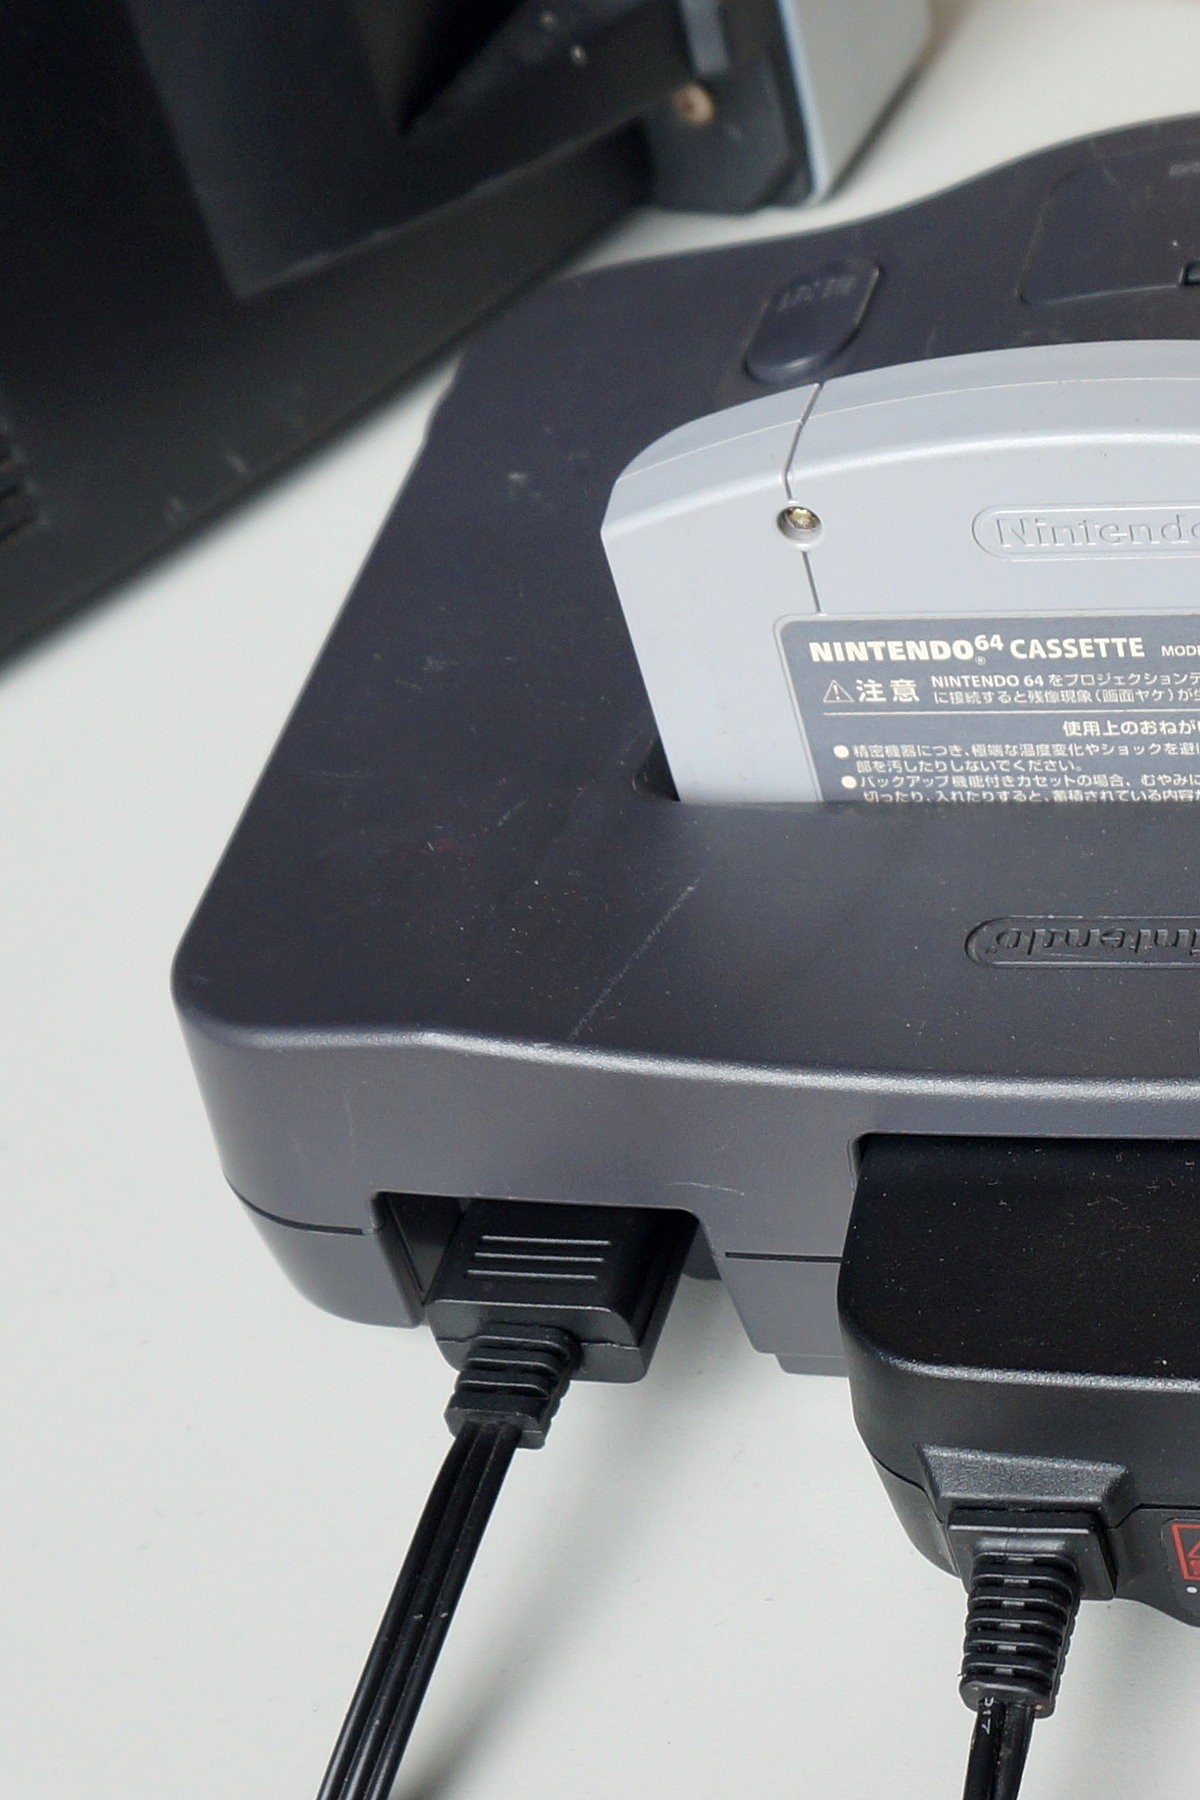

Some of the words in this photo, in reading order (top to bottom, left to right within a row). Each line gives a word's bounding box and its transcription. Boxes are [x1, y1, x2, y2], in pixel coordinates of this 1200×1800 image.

[1009, 636, 1146, 660] CASSETTE
[855, 678, 920, 703] 注意
[930, 674, 1020, 688] NINTENDO
[1023, 674, 1044, 688] 64
